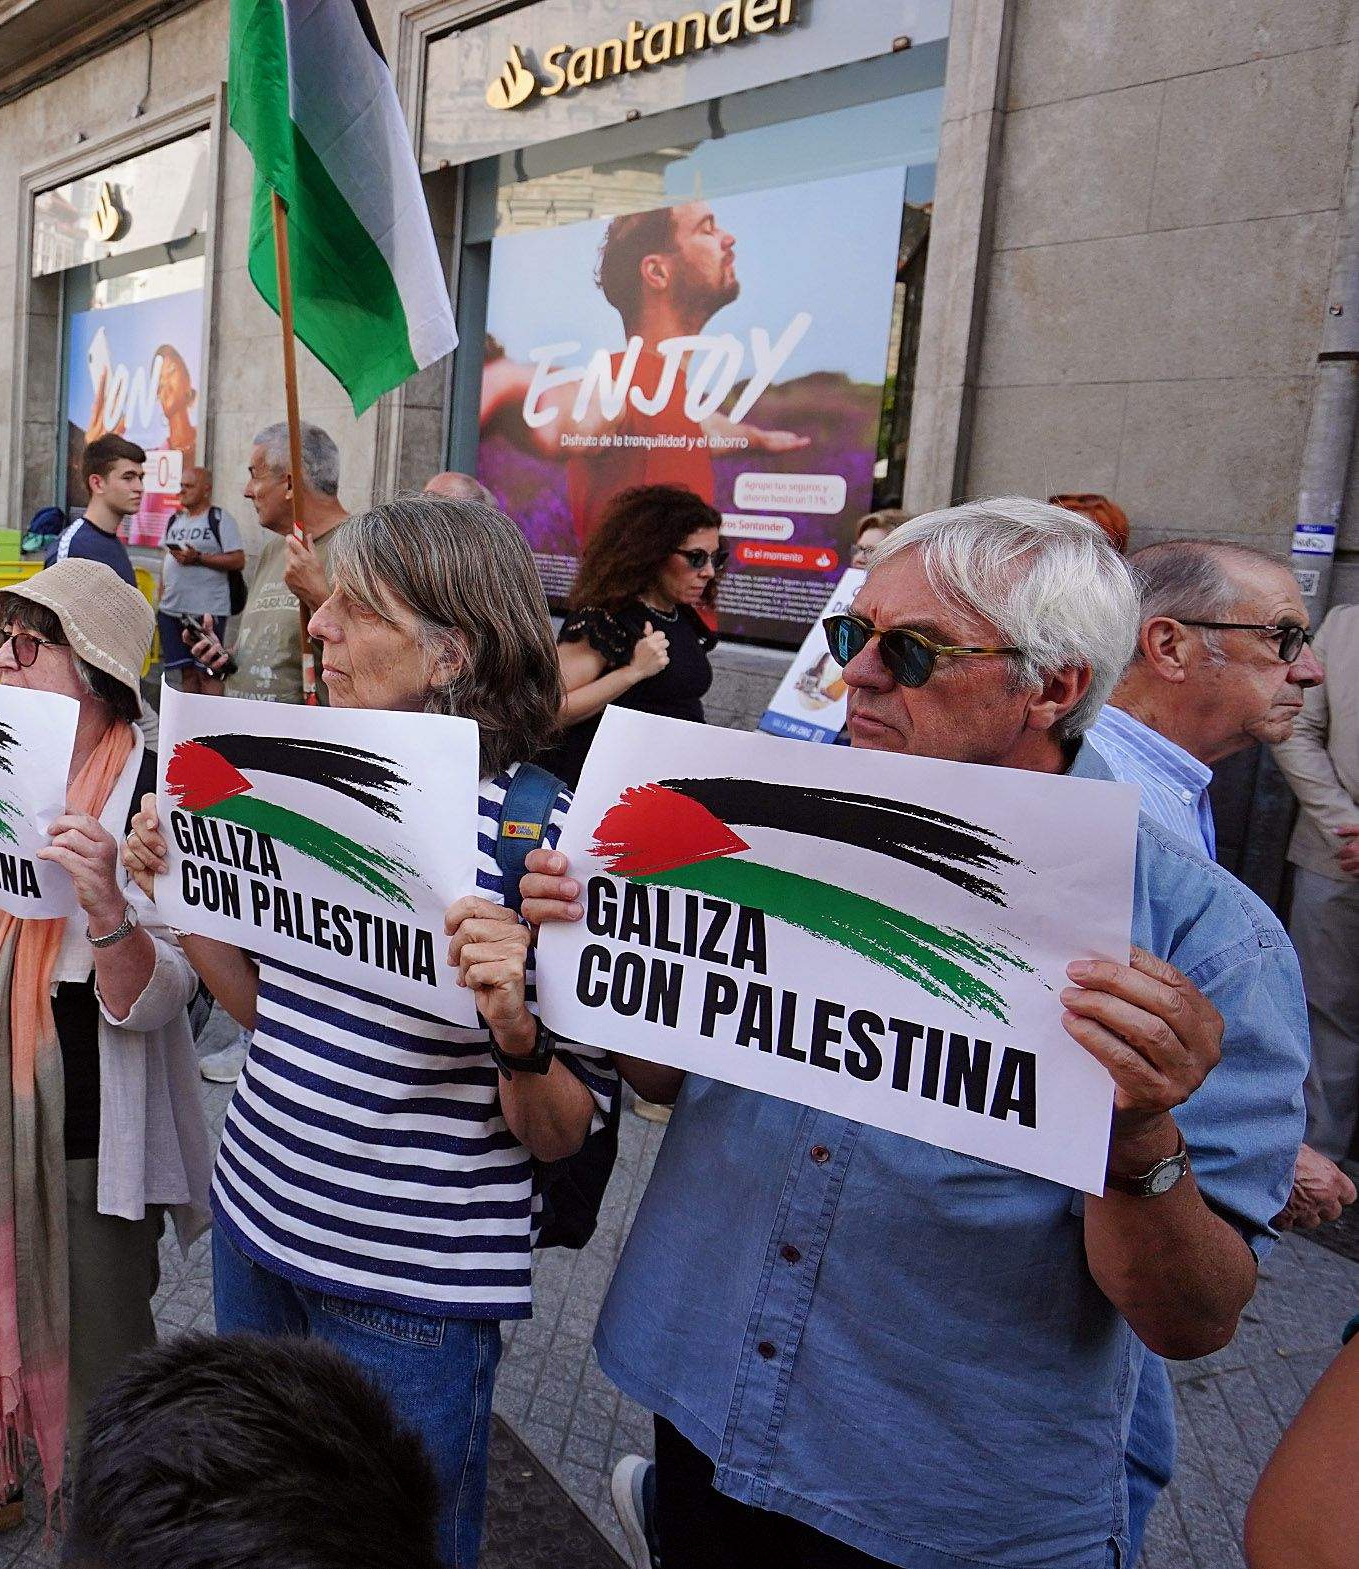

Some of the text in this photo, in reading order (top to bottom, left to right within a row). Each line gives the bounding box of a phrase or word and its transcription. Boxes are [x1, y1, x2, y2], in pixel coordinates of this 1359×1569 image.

[540, 0, 792, 97] Santander
[523, 312, 812, 428] ENJOY
[560, 433, 749, 452] Disfruta de la tranquilidad y el ahorro
[744, 548, 804, 563] Es el momento
[170, 810, 282, 881] GALIZA
[181, 860, 438, 988] CON PALESTINA
[586, 876, 768, 975] GALIZA
[576, 944, 1038, 1129] CON PALESTINA
